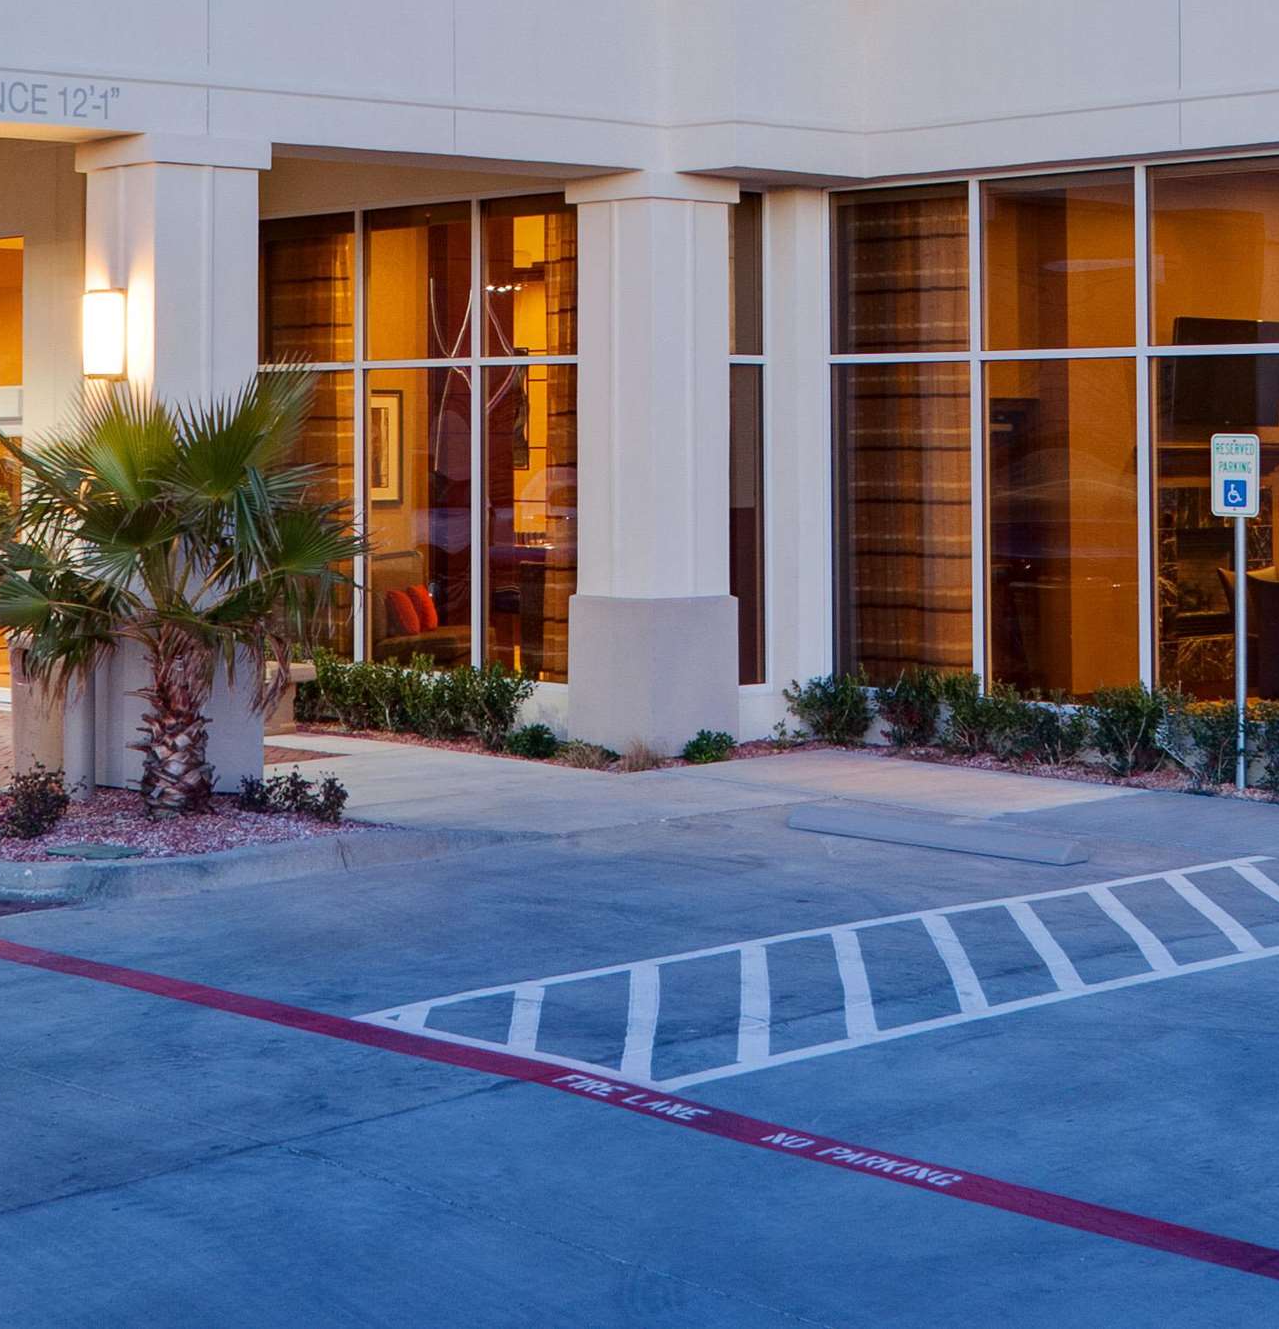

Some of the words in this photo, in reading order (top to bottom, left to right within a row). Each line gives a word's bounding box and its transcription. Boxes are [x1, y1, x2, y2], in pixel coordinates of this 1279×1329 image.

[1216, 442, 1255, 456] RESERVED
[1218, 460, 1253, 475] PARKING
[551, 1073, 627, 1098] FIRE
[621, 1093, 711, 1122] LANE
[760, 1131, 816, 1151] NO
[816, 1145, 963, 1189] PARKING
